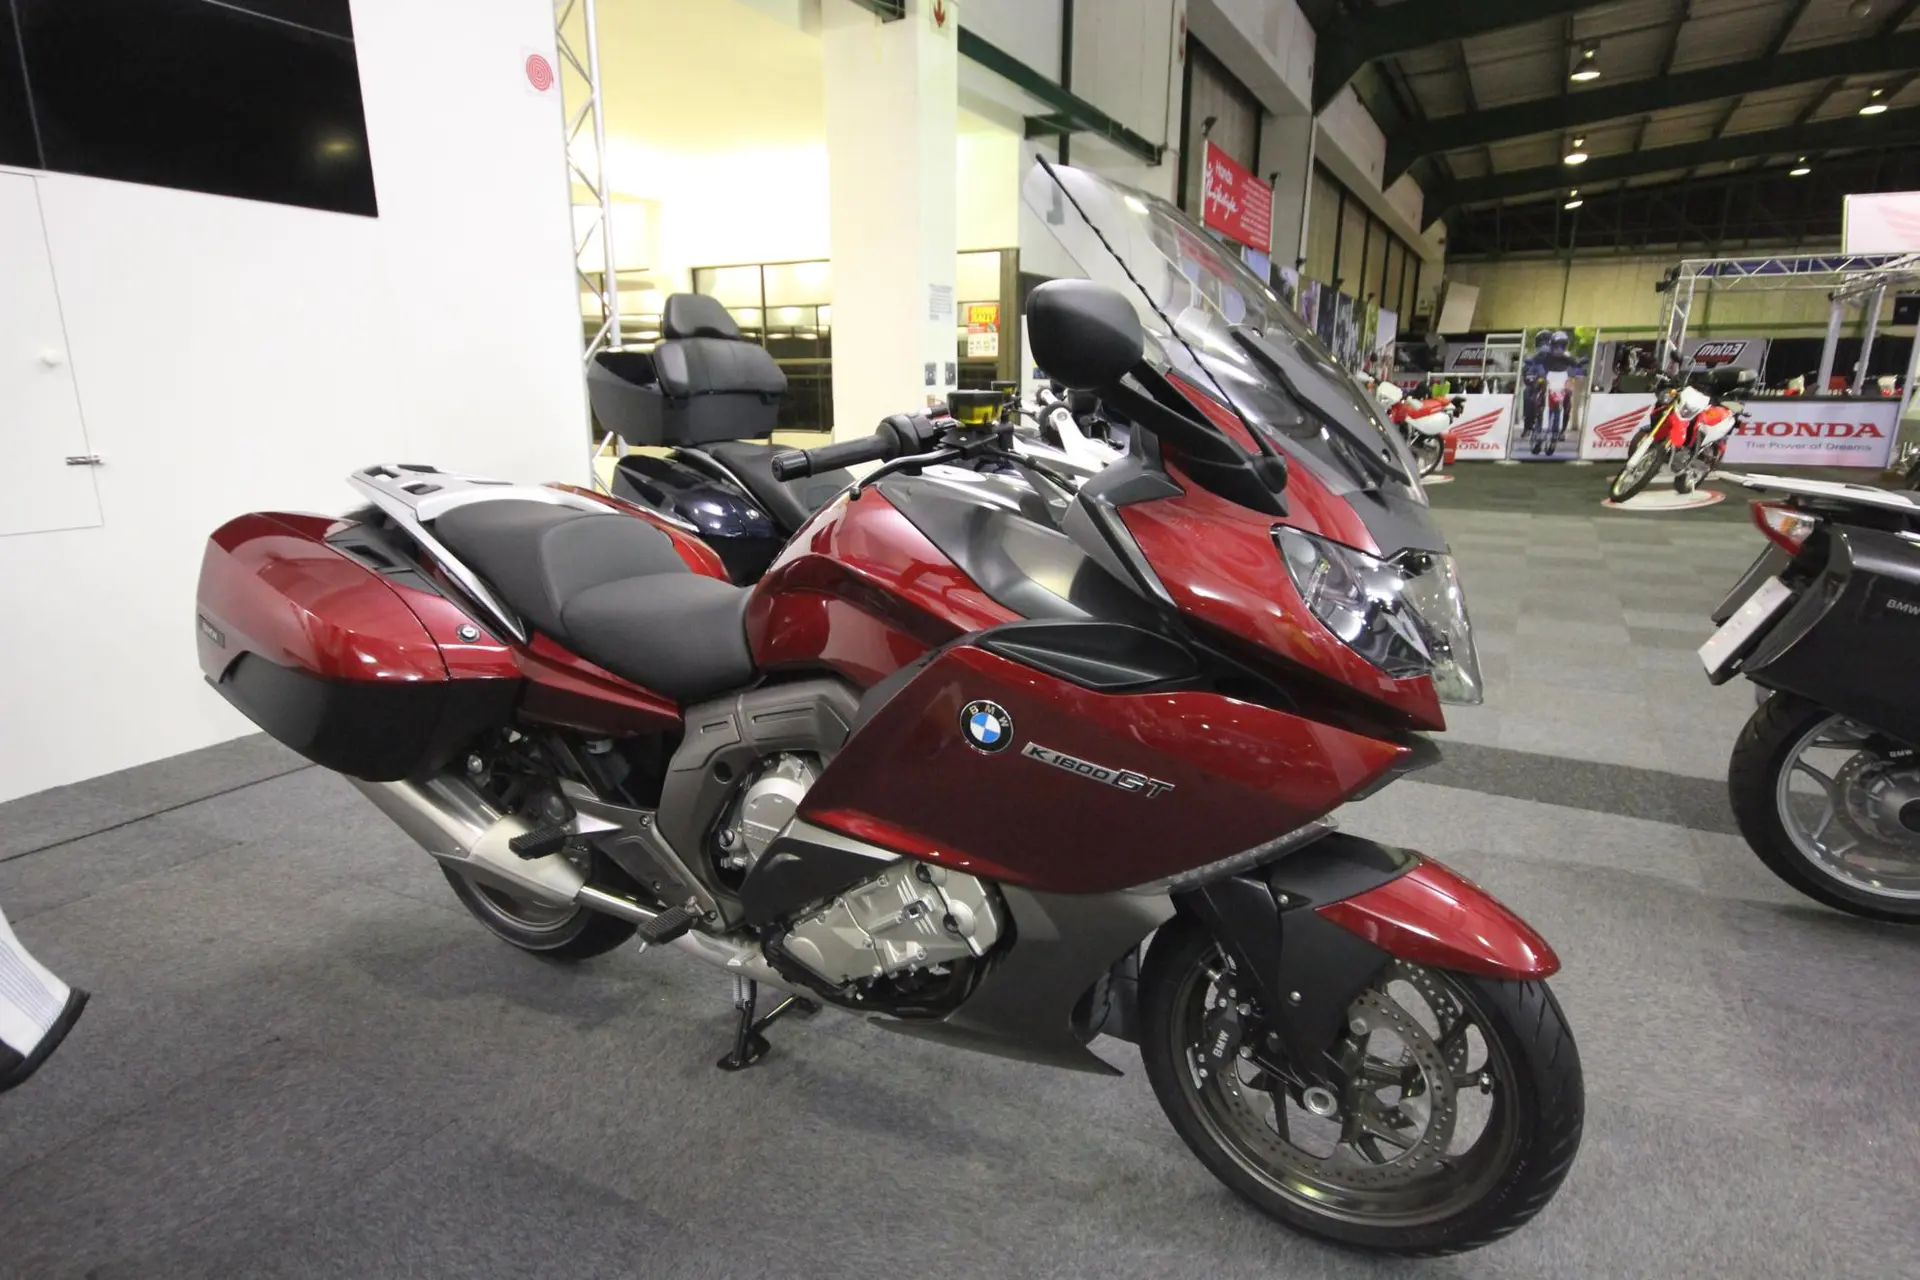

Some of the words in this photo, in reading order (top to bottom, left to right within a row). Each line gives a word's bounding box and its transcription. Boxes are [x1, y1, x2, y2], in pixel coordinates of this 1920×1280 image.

[1735, 422, 1884, 438] HONDA
[1456, 442, 1500, 450] ONDA
[1745, 441, 1765, 449] The
[1769, 441, 1806, 450] Power
[1810, 442, 1823, 451] of
[1826, 442, 1872, 451] Dreams
[1886, 599, 1920, 615] BMW
[969, 704, 1009, 728] BMW
[1212, 1029, 1229, 1058] BMW
